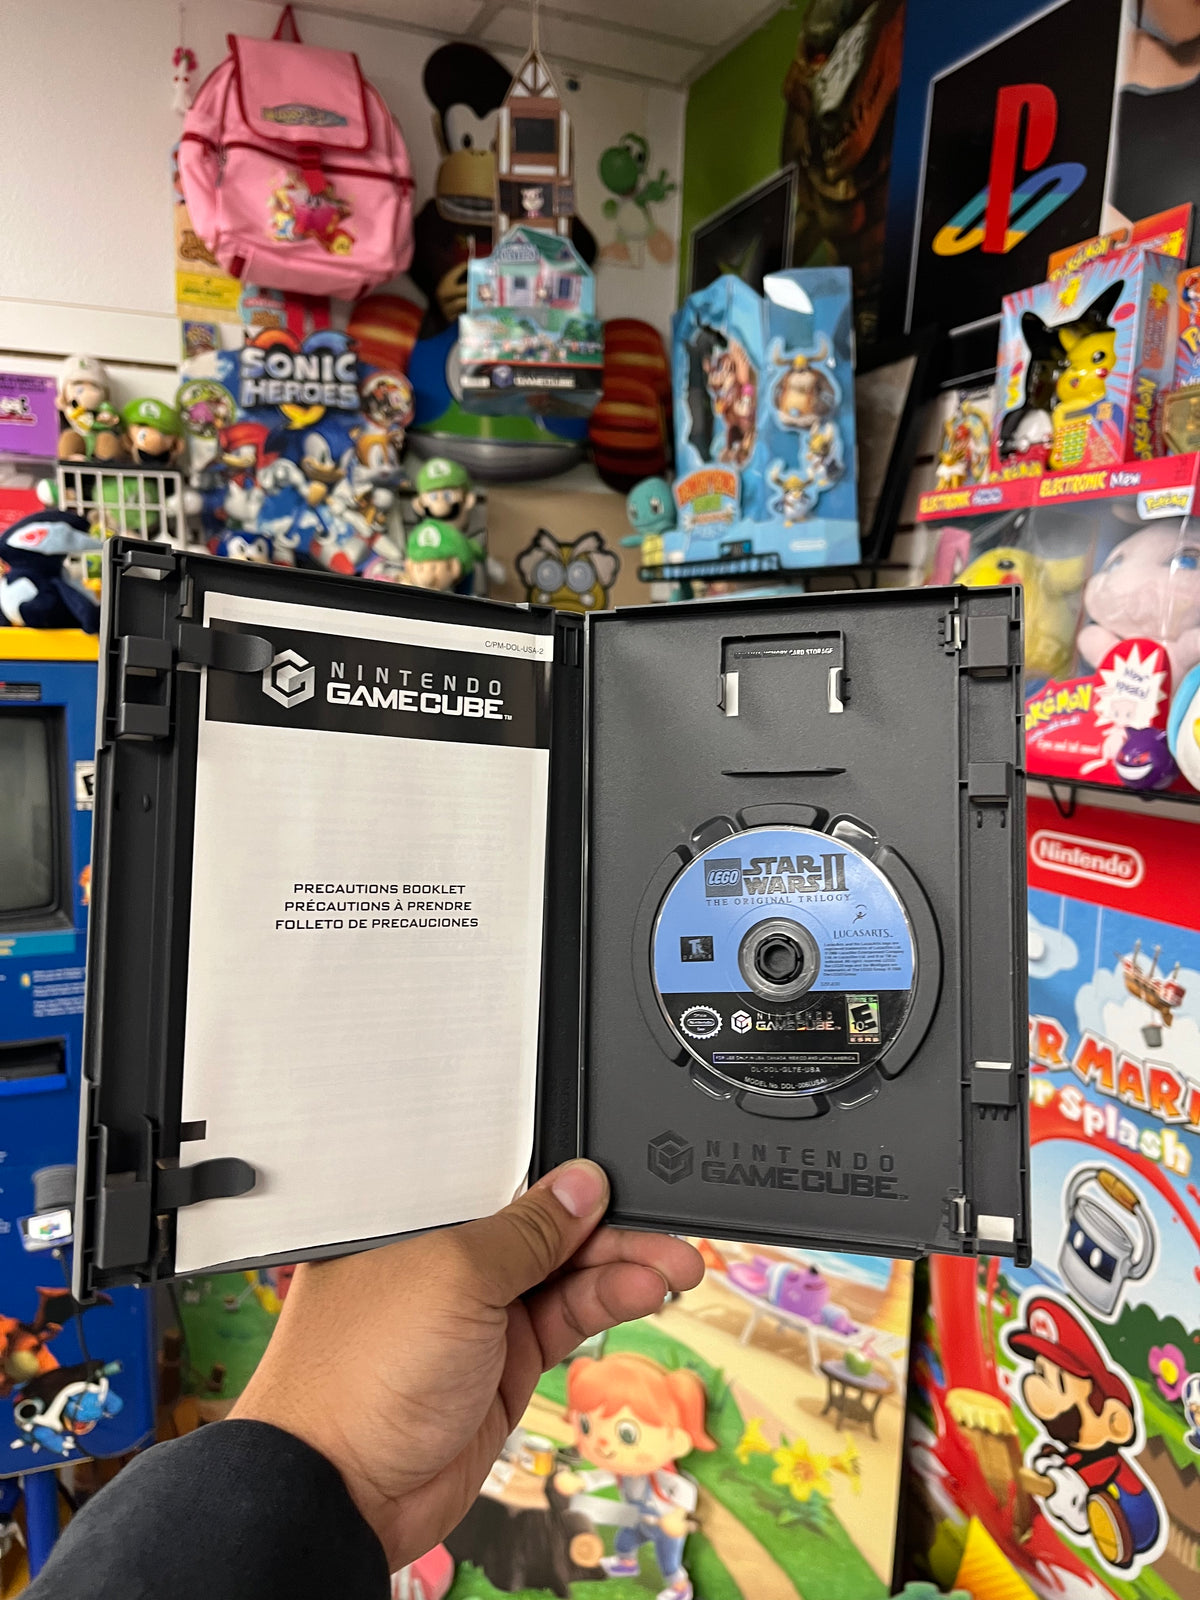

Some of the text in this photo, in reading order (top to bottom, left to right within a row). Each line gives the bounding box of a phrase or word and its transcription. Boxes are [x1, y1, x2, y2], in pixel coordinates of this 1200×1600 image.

[241, 347, 357, 382] SONIC
[241, 379, 360, 408] HEROES
[1039, 472, 1107, 498] ELECTRONIC
[484, 640, 545, 655] C/PM-DOL-USA-2
[331, 661, 501, 696] NINTENDO
[743, 855, 822, 875] STAR
[1040, 839, 1133, 878] Nintendo
[708, 869, 740, 885] LEGO
[743, 875, 822, 895] WARS
[294, 884, 466, 894] PRECAUTIONS BOOKLET
[284, 899, 472, 911] PRÉCAUTIONS À PRENDRE
[735, 896, 792, 905] ORIGINAL
[799, 894, 851, 903] TRILOGY
[275, 918, 479, 930] FOLLETO DE PRECAUCIONES
[1058, 1084, 1192, 1178] Splash
[706, 1140, 894, 1173] NINTENDO
